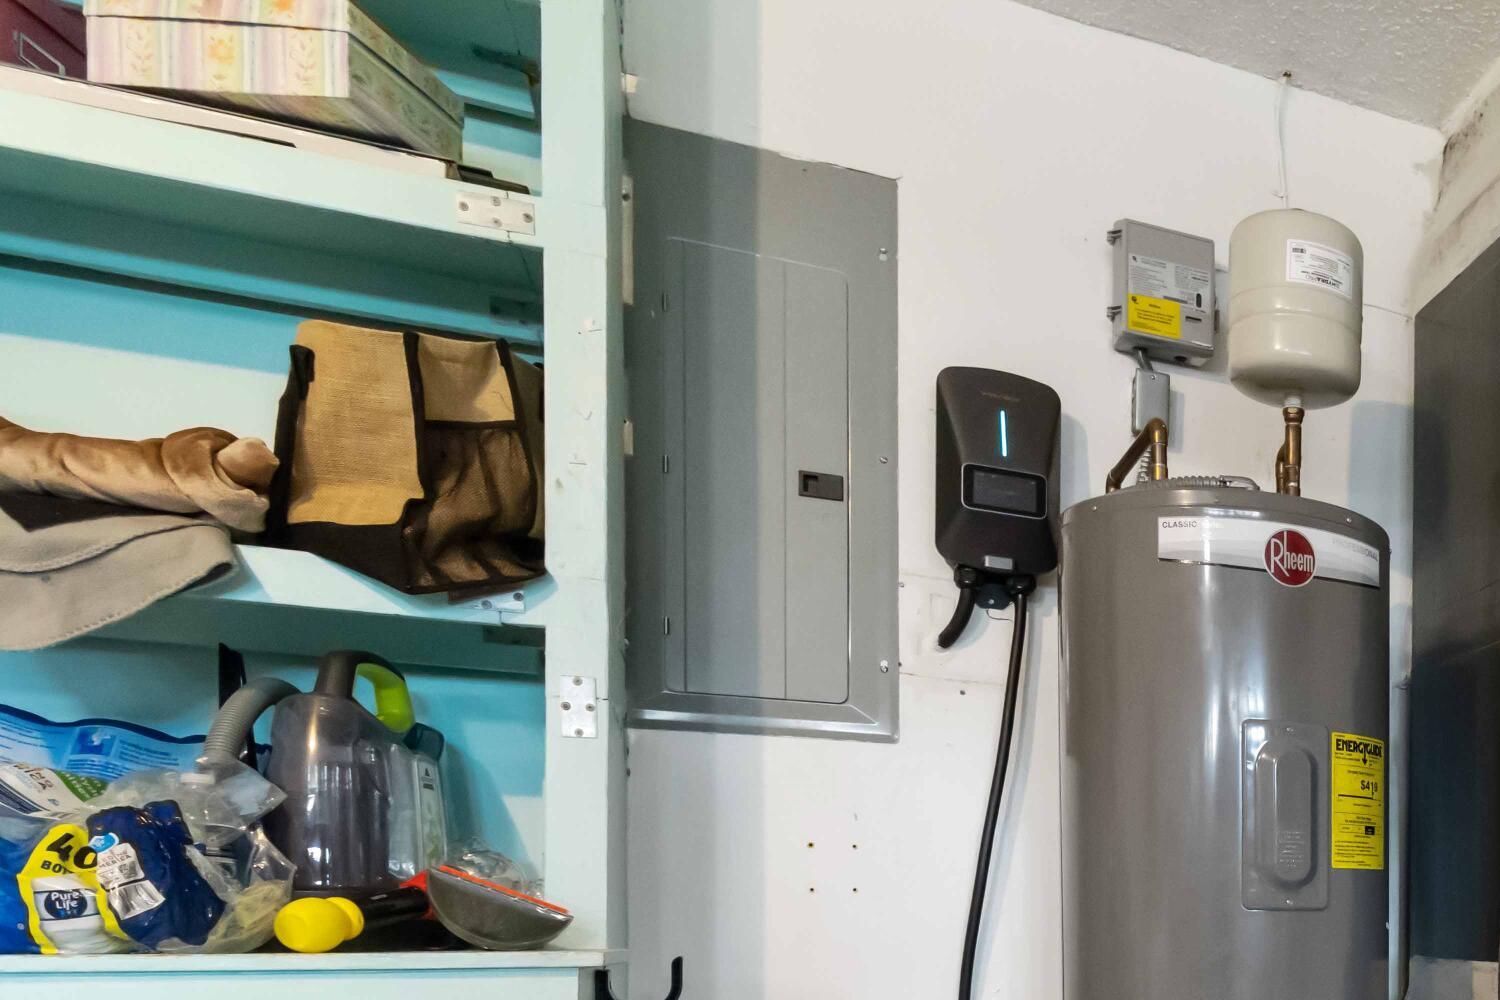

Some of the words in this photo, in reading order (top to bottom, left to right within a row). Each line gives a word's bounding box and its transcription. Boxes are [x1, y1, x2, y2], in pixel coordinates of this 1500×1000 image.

[1161, 520, 1198, 529] CLASSIC
[1270, 530, 1314, 577] Rheem
[46, 832, 98, 870] 40
[51, 891, 80, 901] Pure
[55, 900, 79, 911] Life
